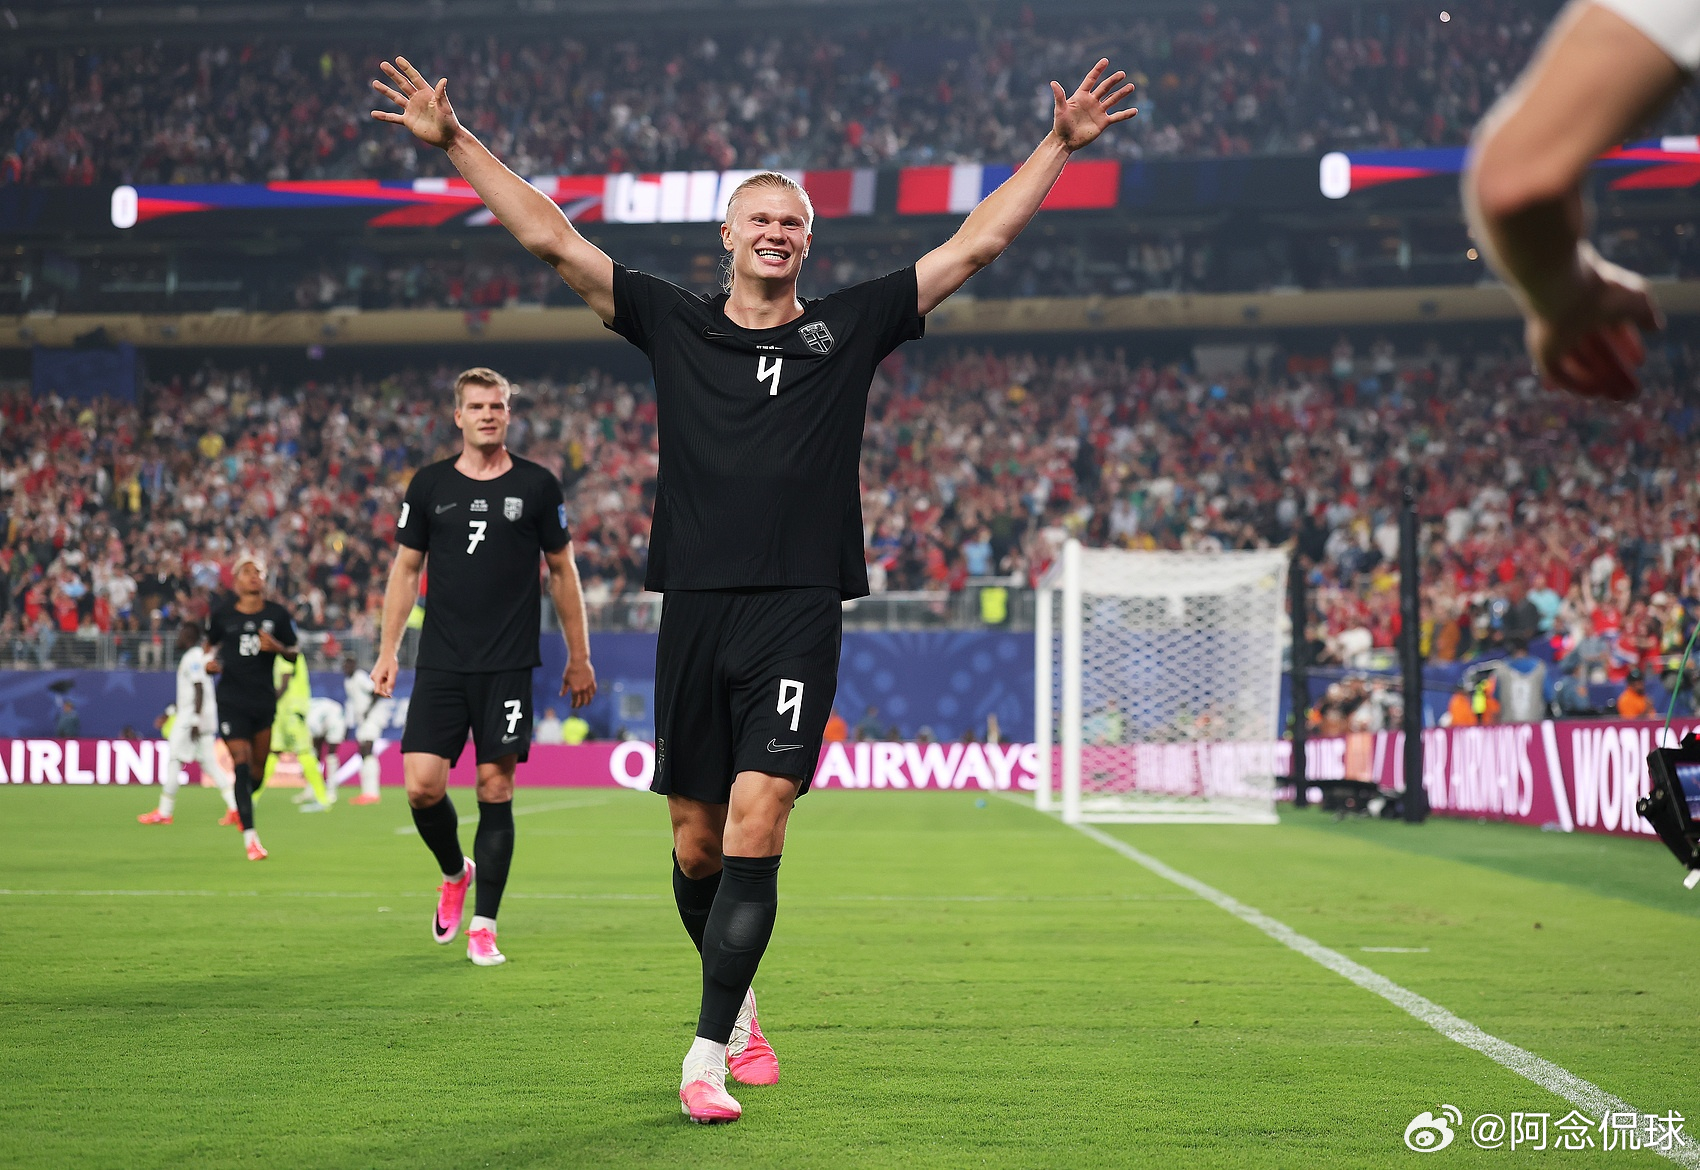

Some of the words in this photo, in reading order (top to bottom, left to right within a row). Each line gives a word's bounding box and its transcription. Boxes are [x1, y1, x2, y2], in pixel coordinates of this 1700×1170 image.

[467, 521, 487, 555] 7
[504, 700, 523, 733] 7
[777, 679, 804, 732] 9
[814, 741, 1036, 789] AIRWAYS
